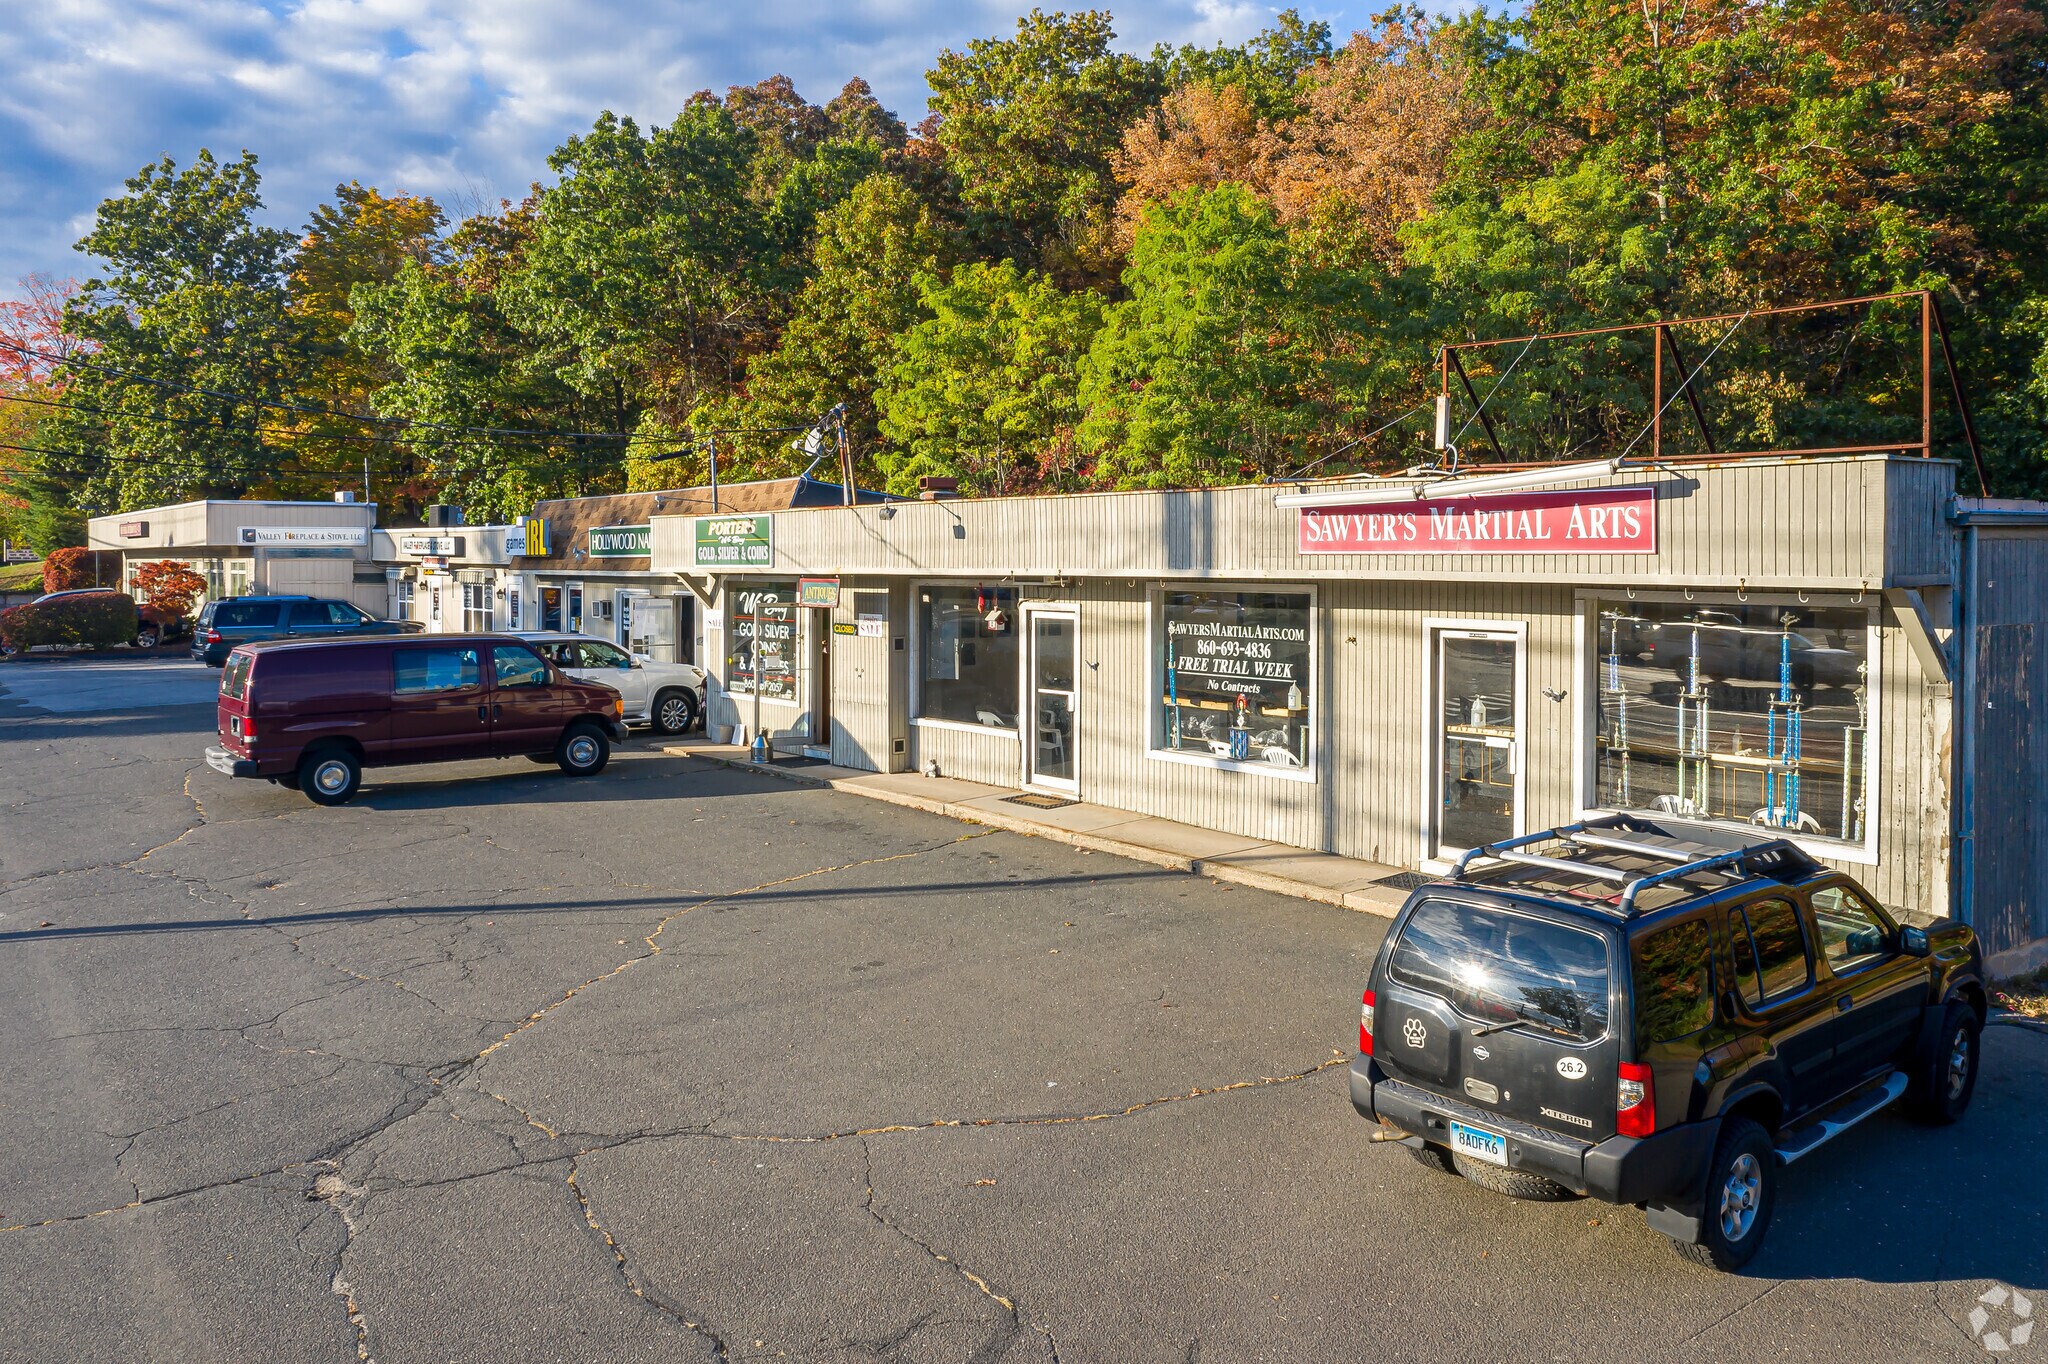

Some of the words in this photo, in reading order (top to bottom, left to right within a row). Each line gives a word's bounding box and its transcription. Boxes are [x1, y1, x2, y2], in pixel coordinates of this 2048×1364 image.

[1306, 510, 1417, 542] SAWYER'S
[1429, 506, 1551, 541] MARTIAL
[1565, 502, 1641, 539] ARTS
[258, 532, 281, 540] VALLEY
[284, 532, 319, 541] FIREPLACE
[506, 536, 525, 554] games
[525, 518, 549, 556] IRL
[591, 533, 636, 550] HOLLYWOOD
[718, 546, 739, 560] SILVER
[740, 546, 746, 560] &
[747, 545, 769, 560] COINS
[804, 586, 837, 600] ANTIQUES
[739, 622, 762, 637] GOD
[765, 624, 790, 640] SILVER
[834, 624, 855, 634] CLOSED
[1197, 639, 1272, 659] 860-693-4836
[739, 656, 747, 670] &
[1178, 656, 1210, 672] FREE
[1213, 658, 1250, 675] TRIAL
[1253, 661, 1294, 678] WEEK
[1207, 679, 1219, 690] No
[1221, 680, 1261, 694] Contracts
[1560, 1062, 1584, 1074] 26.2
[1540, 1106, 1593, 1129] XTERRA
[1459, 1132, 1498, 1155] 8ADFK6
